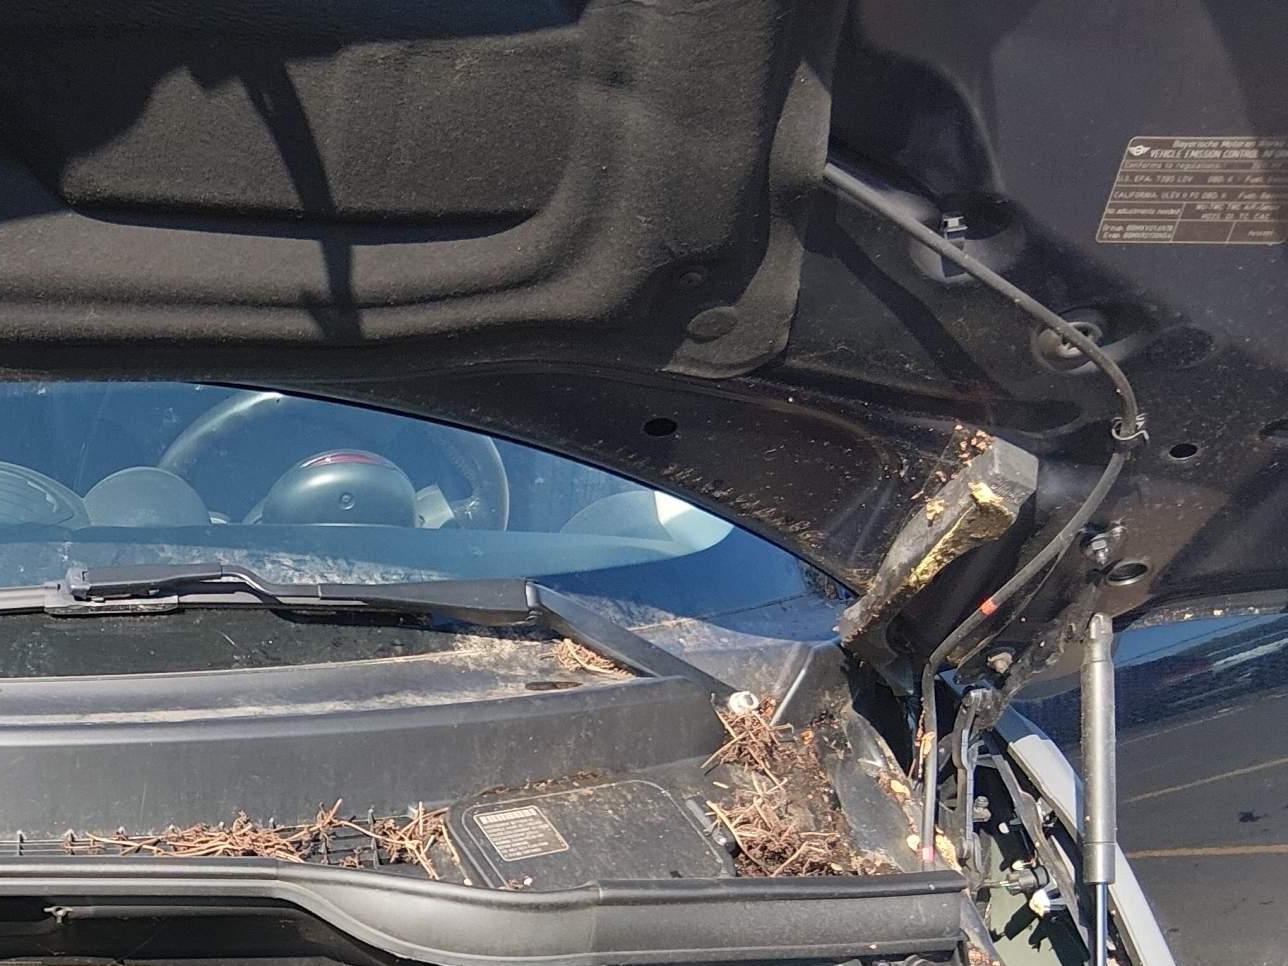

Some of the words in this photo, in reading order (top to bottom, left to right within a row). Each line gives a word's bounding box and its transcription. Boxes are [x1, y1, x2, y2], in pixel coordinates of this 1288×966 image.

[1150, 149, 1182, 159] VEHICLE
[1184, 149, 1221, 159] EMISSION
[1222, 149, 1258, 159] CONTROL
